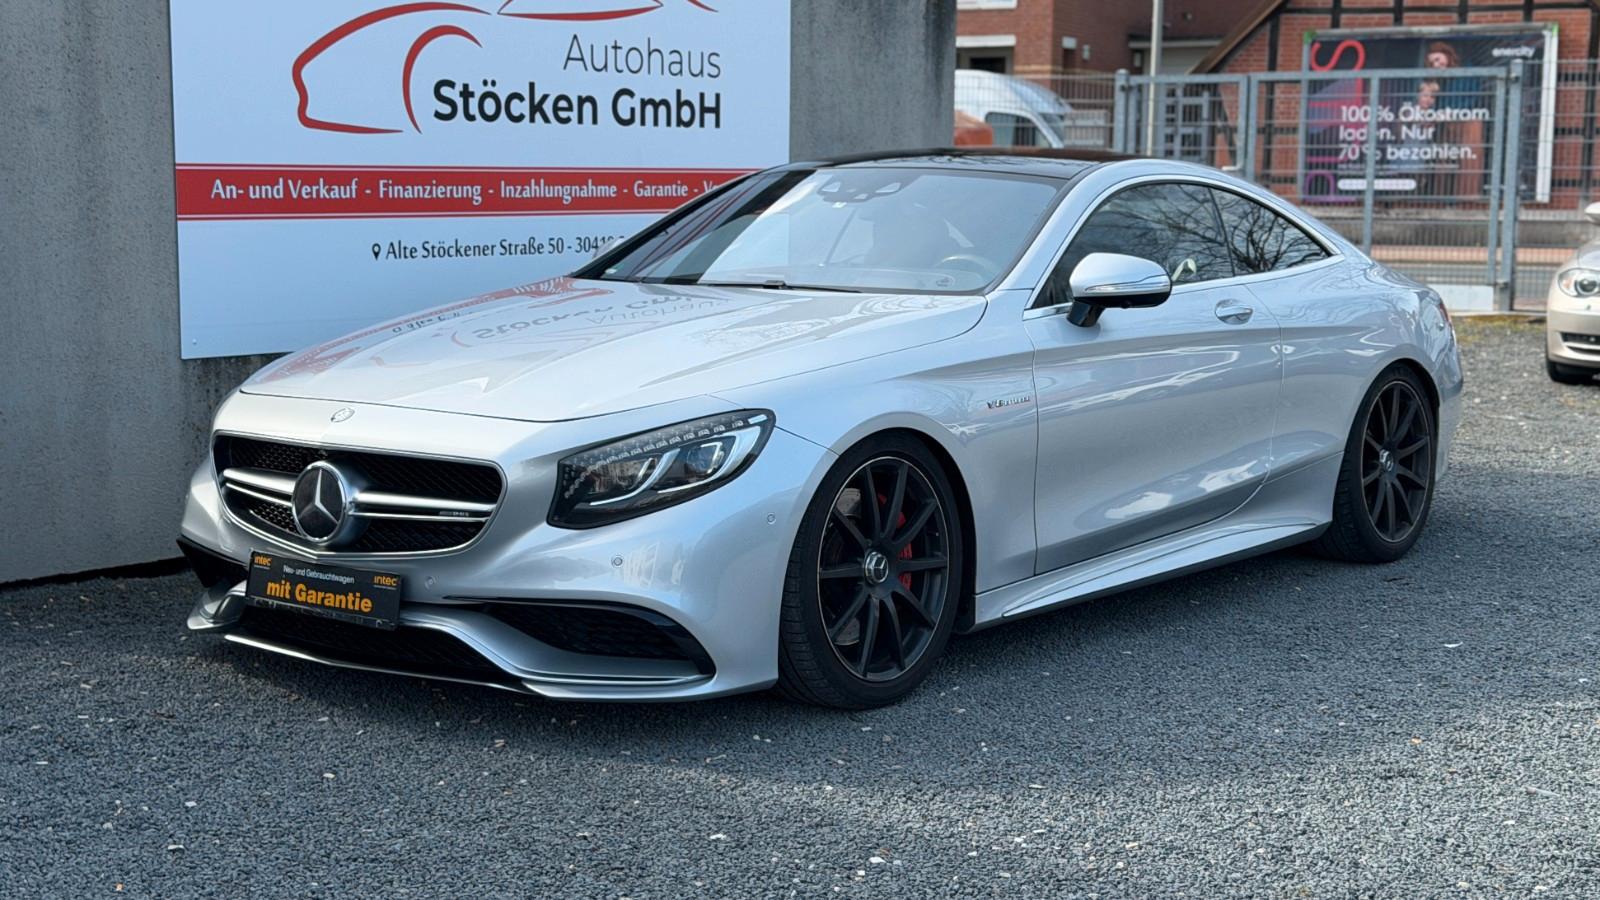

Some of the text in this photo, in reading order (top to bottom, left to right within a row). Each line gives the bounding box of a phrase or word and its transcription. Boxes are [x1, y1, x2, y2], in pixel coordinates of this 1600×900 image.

[563, 33, 721, 78] Autohaus
[432, 78, 721, 129] Stöcken GmbH
[1399, 102, 1490, 122] Ökostrom
[1338, 125, 1435, 141] ladn. Nur
[1386, 143, 1477, 161] bezahlen.
[211, 178, 244, 199] An-
[249, 177, 284, 199] und
[288, 177, 359, 199] Verkauf
[379, 179, 482, 206] Finanzierung
[500, 178, 618, 204] Inzahlungnahme
[633, 179, 689, 198] Garantie
[386, 240, 418, 260] Alte
[421, 238, 497, 259] Stöckener
[499, 236, 545, 255] Straße
[548, 237, 565, 254] 50
[254, 555, 272, 567] intec
[295, 568, 306, 576] und
[306, 568, 355, 584] Gebrauchtwagen
[374, 575, 397, 586] intec
[266, 580, 373, 612] mit Garantie
